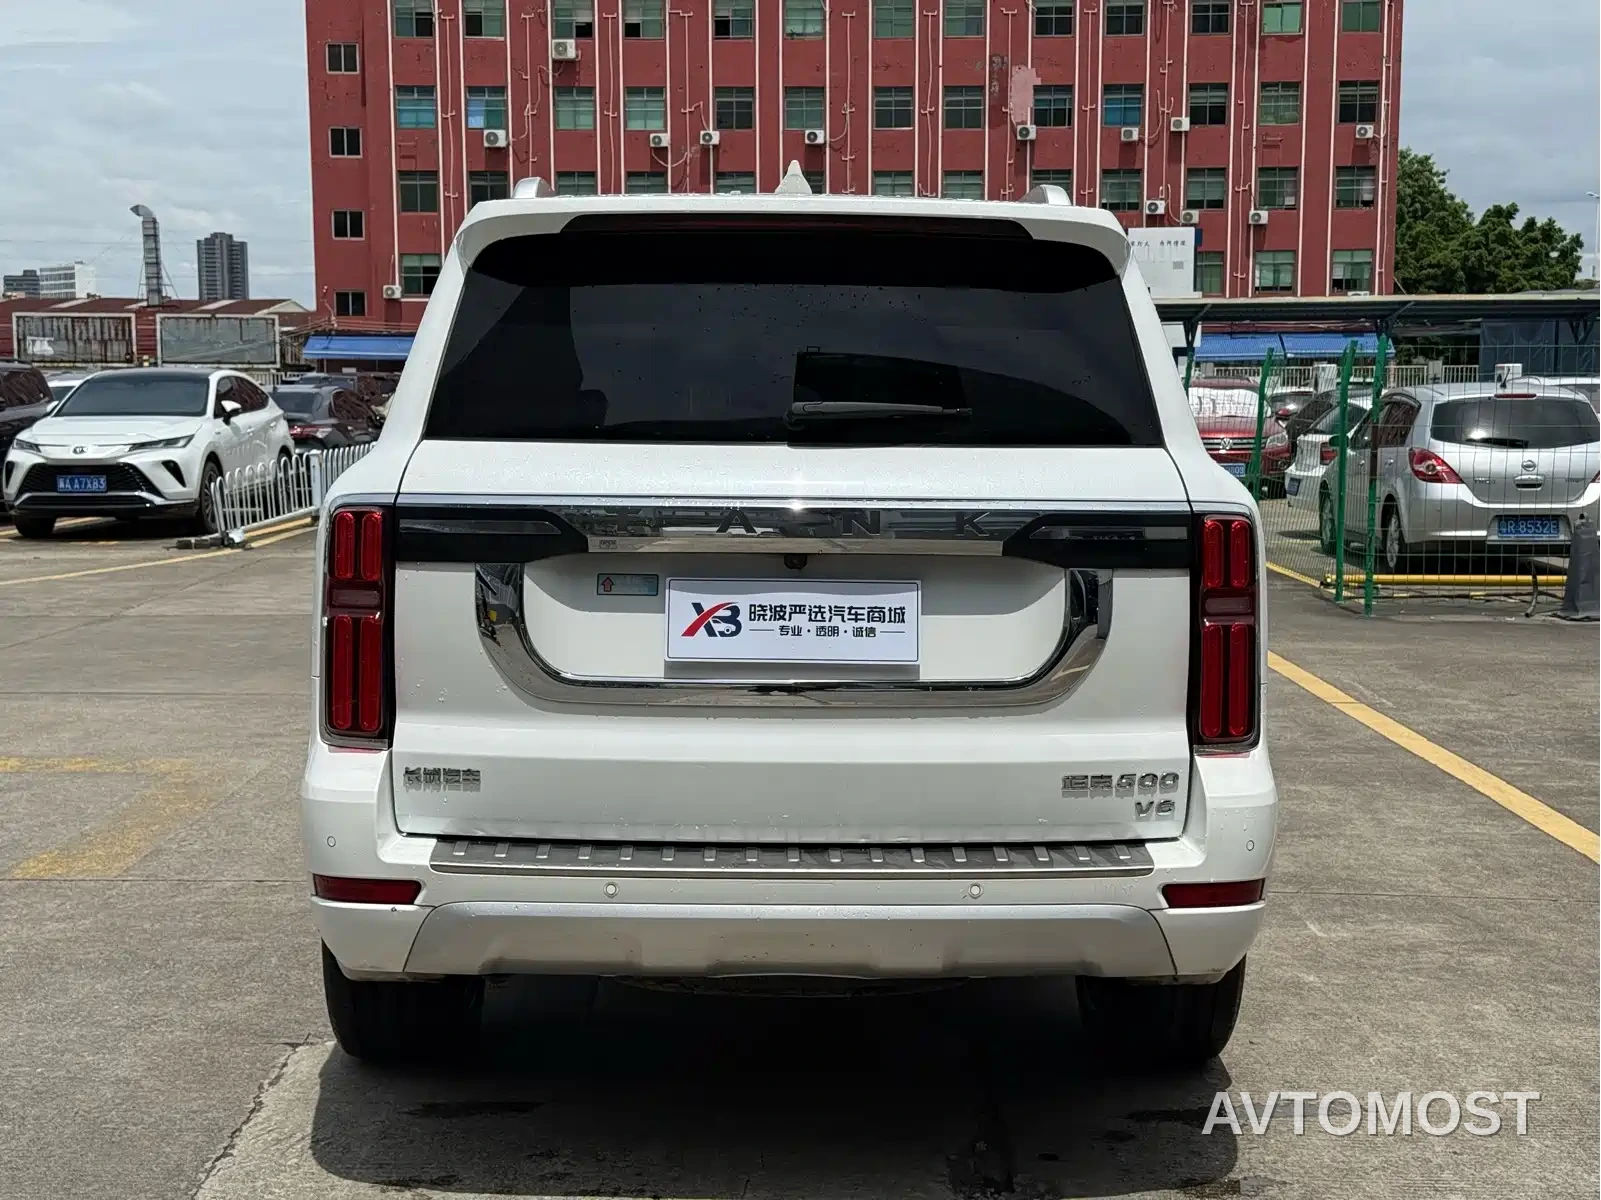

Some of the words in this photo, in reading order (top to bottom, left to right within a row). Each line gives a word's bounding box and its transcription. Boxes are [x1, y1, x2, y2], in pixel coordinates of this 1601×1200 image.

[605, 509, 990, 537] TANK
[749, 603, 906, 624] 晓波严选汽车商城
[1134, 800, 1176, 817] V6
